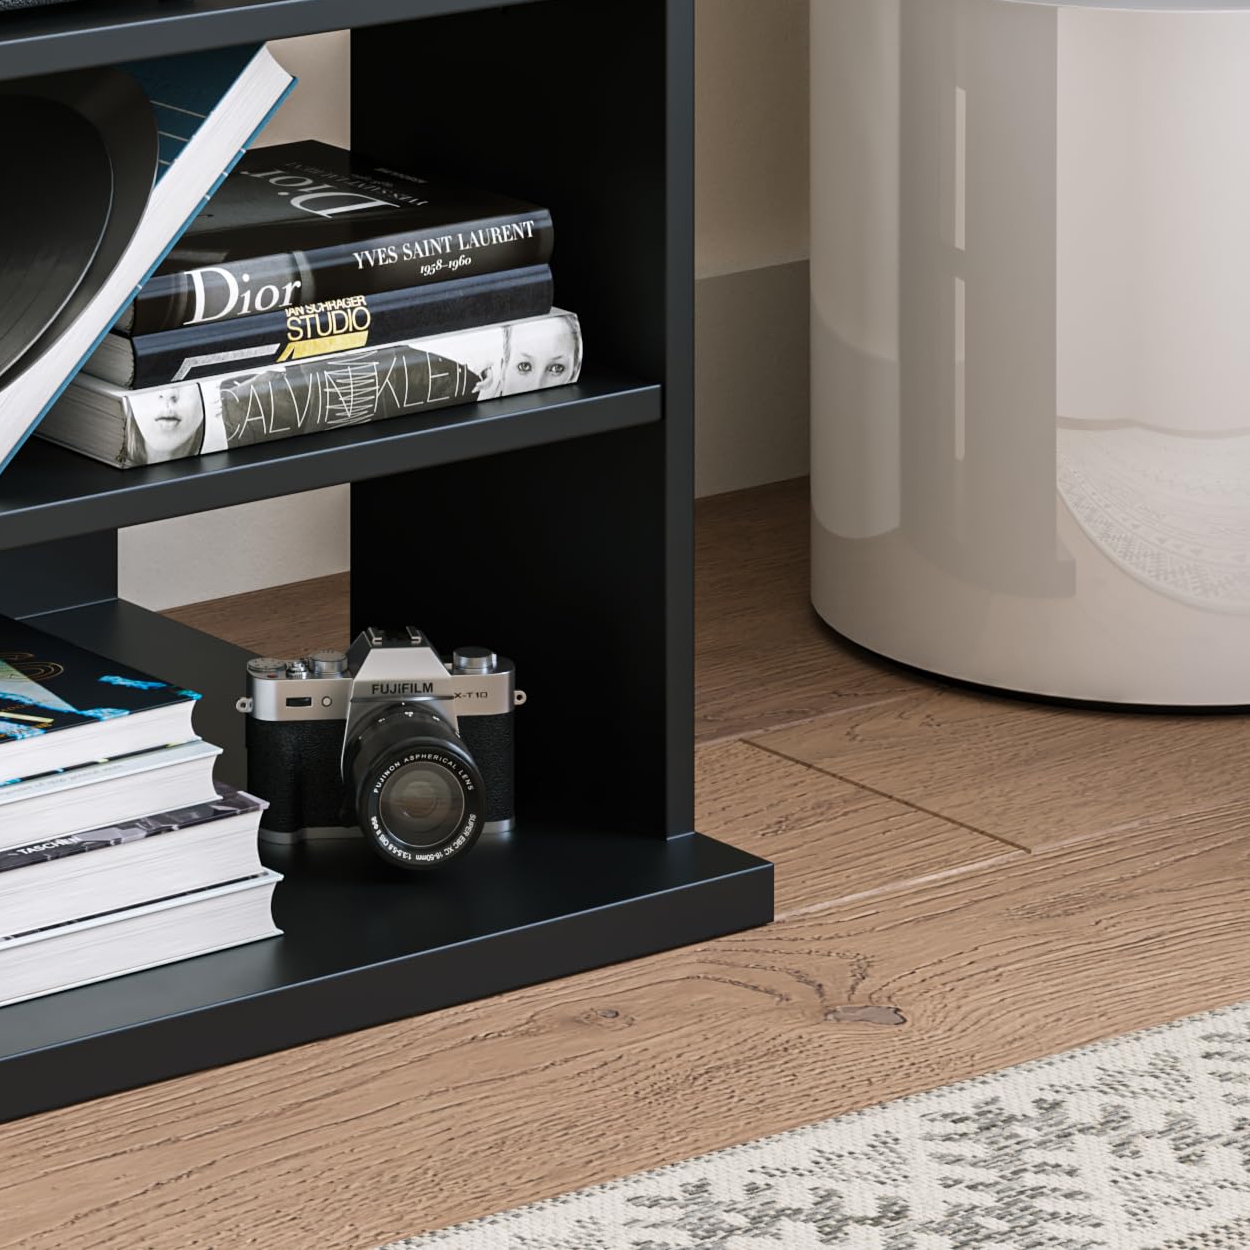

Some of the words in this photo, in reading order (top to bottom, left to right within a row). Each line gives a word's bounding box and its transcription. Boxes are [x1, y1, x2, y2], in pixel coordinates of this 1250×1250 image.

[239, 168, 400, 219] Dior
[353, 246, 399, 270] YVES
[402, 235, 454, 261] SAINT
[458, 220, 535, 251] LAURENT
[183, 267, 301, 325] Dior
[285, 305, 305, 318] IAN
[305, 294, 367, 314] SCHRAGER
[287, 306, 371, 341] STUDIO
[221, 365, 355, 440] CALVIN
[372, 682, 434, 695] FUJIFILM
[454, 691, 488, 699] X-T10
[373, 761, 401, 794] FUJINON
[404, 753, 458, 770] ASPHERICAL
[458, 769, 475, 791] LENS
[463, 813, 477, 837] SUPER
[16, 836, 82, 855] TASCHEN
[443, 846, 455, 856] XC
